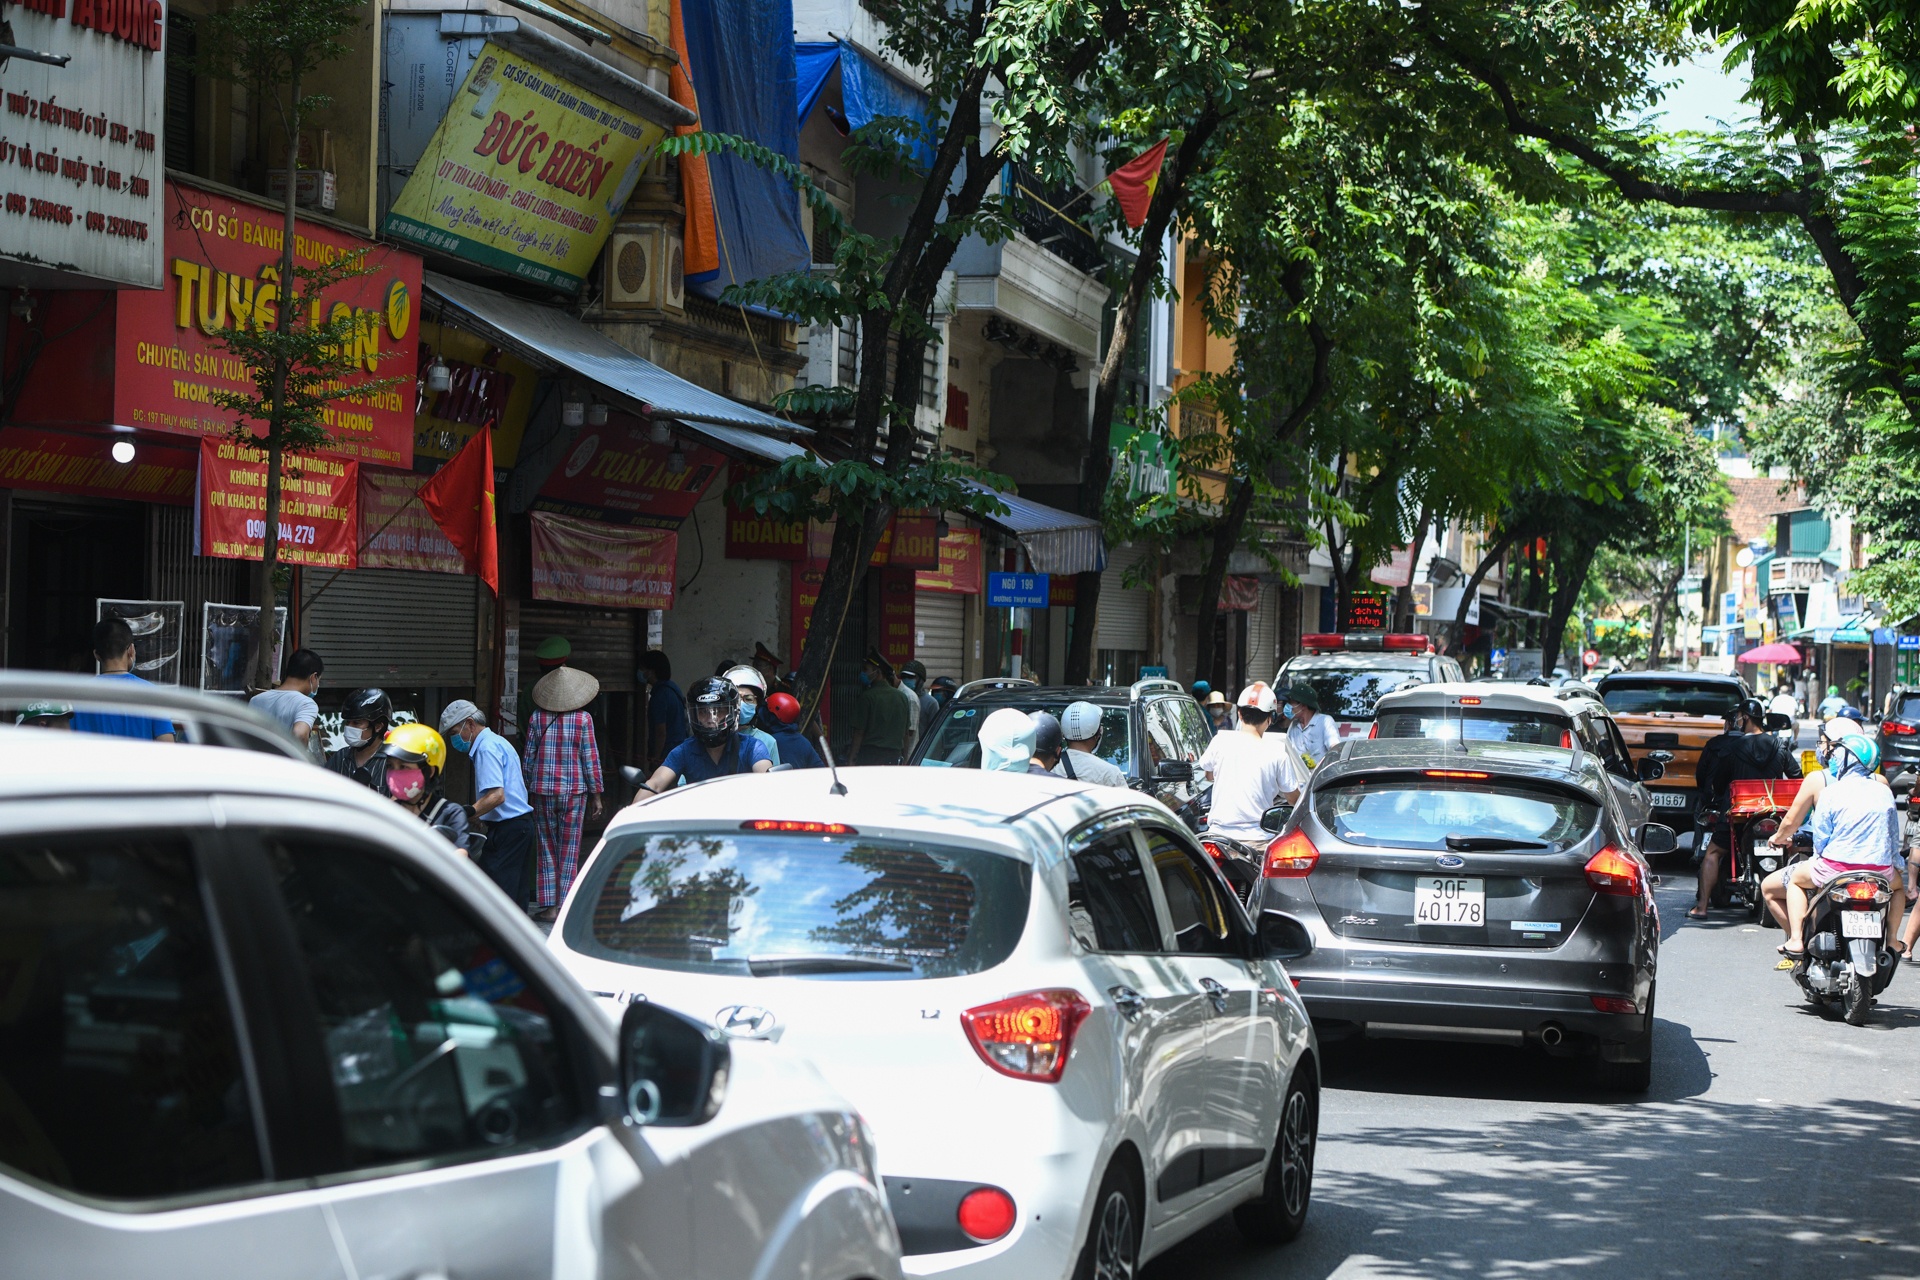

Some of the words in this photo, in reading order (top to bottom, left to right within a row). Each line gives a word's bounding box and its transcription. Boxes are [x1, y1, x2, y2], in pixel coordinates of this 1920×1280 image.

[503, 63, 517, 78] CƠ
[557, 91, 578, 111] BÁNH
[575, 100, 600, 121] TRUNG
[30, 99, 38, 119] 2
[85, 115, 92, 134] 6
[135, 129, 155, 153] 20H
[474, 110, 549, 174] ĐỨC
[9, 144, 16, 164] 7
[18, 142, 33, 170] VÀ
[130, 175, 149, 199] 20H
[437, 160, 455, 179] UY
[451, 163, 469, 185] TÍN
[467, 170, 489, 192] LÂU
[484, 178, 509, 200] NĂM
[510, 189, 536, 211] CHẤT
[532, 198, 558, 221] LƯỢNG
[558, 206, 583, 229] HÀNG
[6, 192, 26, 215] 098
[86, 210, 105, 232] 098
[190, 206, 213, 233] CƠ
[217, 207, 239, 240] SỞ
[242, 218, 284, 252] BÁNH
[193, 347, 218, 377] SẢN
[147, 412, 159, 425] 197
[217, 440, 235, 459] CỬA
[287, 455, 302, 470] LAN
[303, 455, 328, 474] THÔNG
[229, 468, 259, 487] KHÔNG
[303, 479, 315, 498] TẠI
[210, 490, 225, 508] QUÝ
[227, 490, 256, 510] KHÁCH
[307, 503, 321, 518] XIN
[322, 502, 338, 521] LIÊN
[294, 524, 315, 545] 279
[1021, 578, 1034, 590] 199
[889, 624, 910, 636] MUA
[889, 642, 909, 656] BÁN
[1431, 879, 1468, 900] 30F
[1418, 902, 1482, 923] 401.78
[1849, 913, 1875, 924] 29-F1
